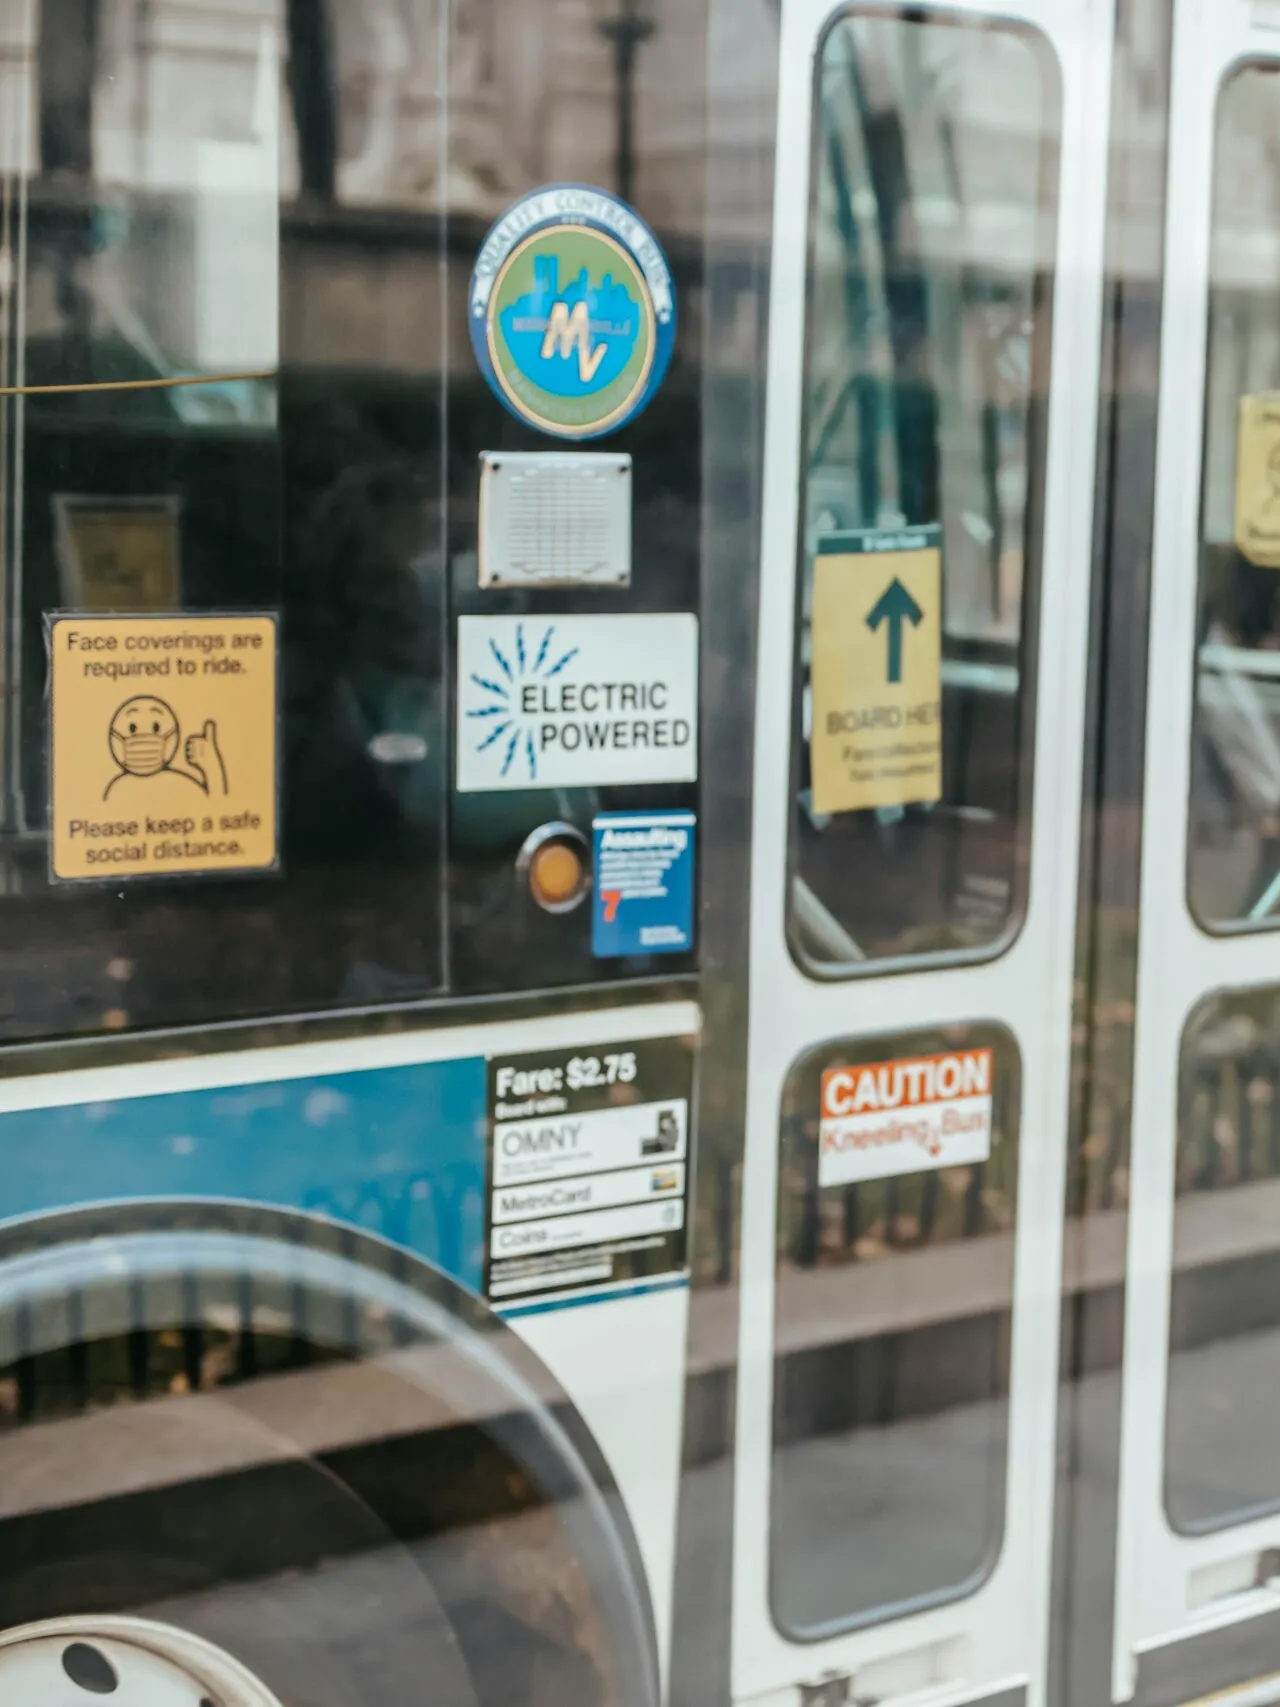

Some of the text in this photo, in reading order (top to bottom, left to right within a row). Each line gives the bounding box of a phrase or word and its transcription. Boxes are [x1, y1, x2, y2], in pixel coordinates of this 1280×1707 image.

[67, 630, 263, 656] Face coverings are
[83, 655, 247, 681] required to ride.
[521, 682, 668, 714] ELECTRIC
[540, 719, 690, 752] POWERED
[825, 705, 901, 736] BOARD
[68, 813, 261, 839] Please keep a safe
[86, 839, 246, 864] social distance.
[601, 890, 621, 922] 7
[496, 1052, 637, 1098] Fare: $2.75
[826, 1055, 990, 1114] CAUTION
[502, 1122, 582, 1157] OMNY
[821, 1110, 989, 1153] Kneeling Bus
[501, 1186, 592, 1212] MetroCard
[500, 1228, 547, 1249] Coins
